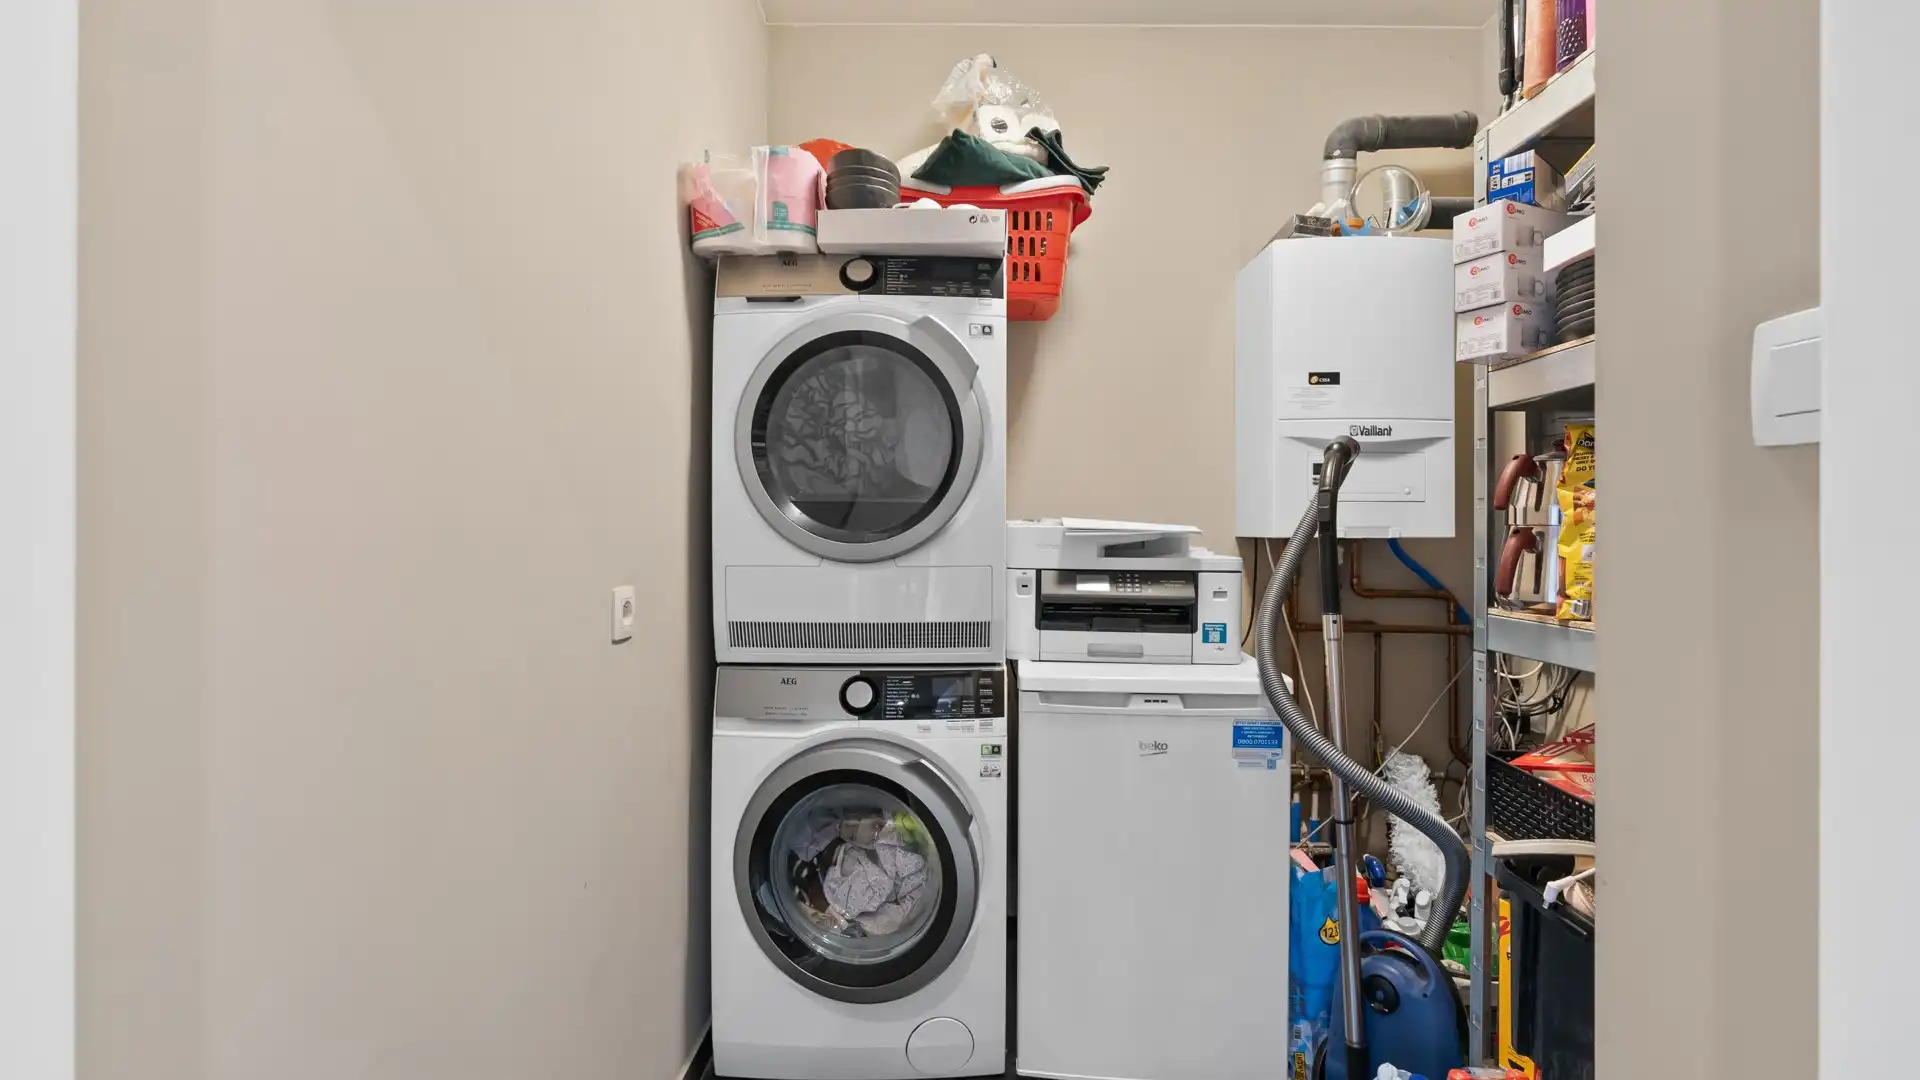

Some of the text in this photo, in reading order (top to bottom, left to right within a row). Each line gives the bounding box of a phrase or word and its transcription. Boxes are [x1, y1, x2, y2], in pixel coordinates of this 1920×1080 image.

[1358, 425, 1392, 436] Vaillant
[780, 678, 797, 686] AEG
[1139, 740, 1169, 752] beko
